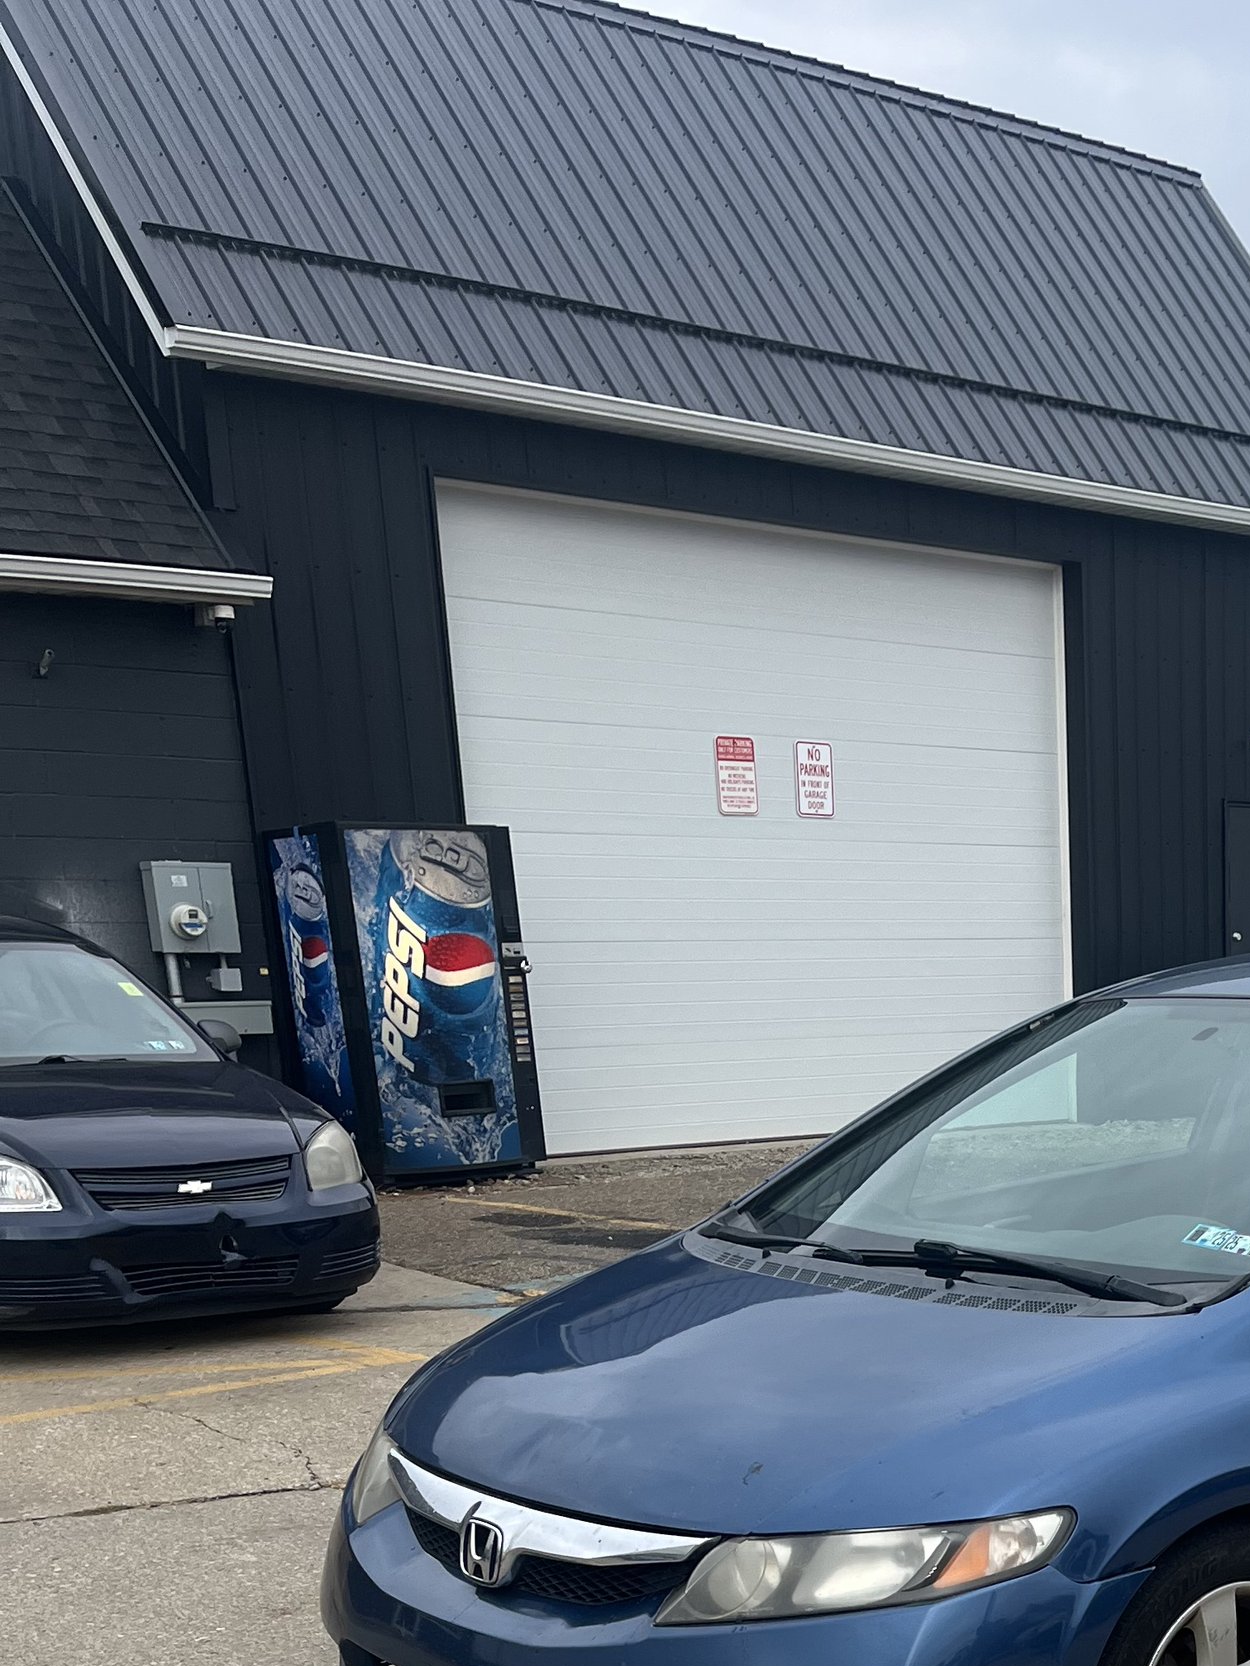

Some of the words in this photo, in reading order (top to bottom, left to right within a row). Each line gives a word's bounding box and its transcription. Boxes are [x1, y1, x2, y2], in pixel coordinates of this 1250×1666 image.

[807, 748, 821, 761] NO
[800, 763, 830, 777] PARKING
[808, 780, 822, 788] FRONT
[823, 781, 830, 789] OF
[804, 790, 827, 799] GARAGE
[808, 801, 824, 810] DOOR
[288, 919, 308, 1019] PEPSI
[381, 895, 427, 1073] PEPSI
